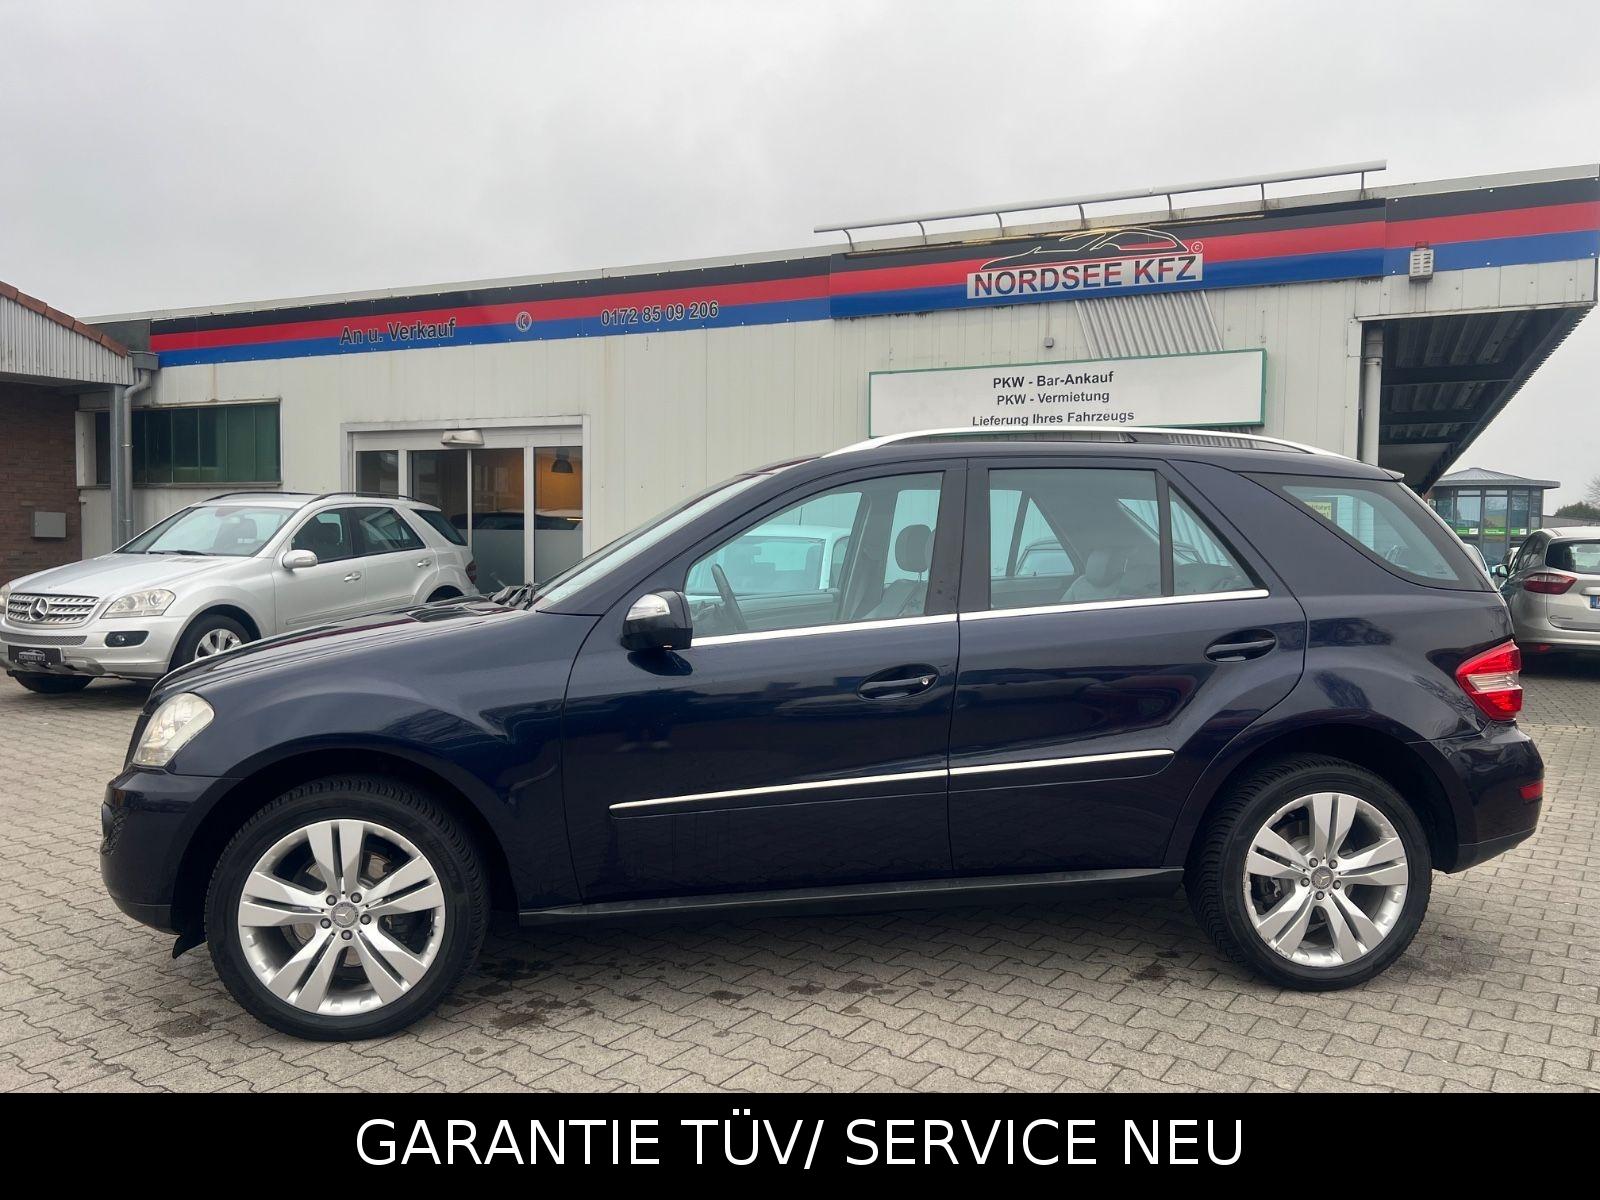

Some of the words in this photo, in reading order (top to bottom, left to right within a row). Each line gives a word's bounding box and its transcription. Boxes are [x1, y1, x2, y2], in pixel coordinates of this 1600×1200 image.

[974, 262, 1123, 297] NORDSEE
[1134, 255, 1197, 285] KFZ
[601, 307, 638, 326] 0172
[642, 305, 661, 323] 85
[665, 303, 685, 321] 09
[689, 300, 718, 319] 206
[340, 326, 363, 345] An
[368, 328, 383, 343] u.
[388, 318, 456, 342] Verkauf
[993, 376, 1024, 389] PKW
[1036, 371, 1114, 387] Bar-Ankauf
[997, 394, 1026, 406] PKW
[1037, 391, 1110, 404] Vermietung
[972, 415, 1029, 427] Lieferung
[1032, 413, 1063, 425] Ihres
[1067, 411, 1134, 423] Fahrzeugs
